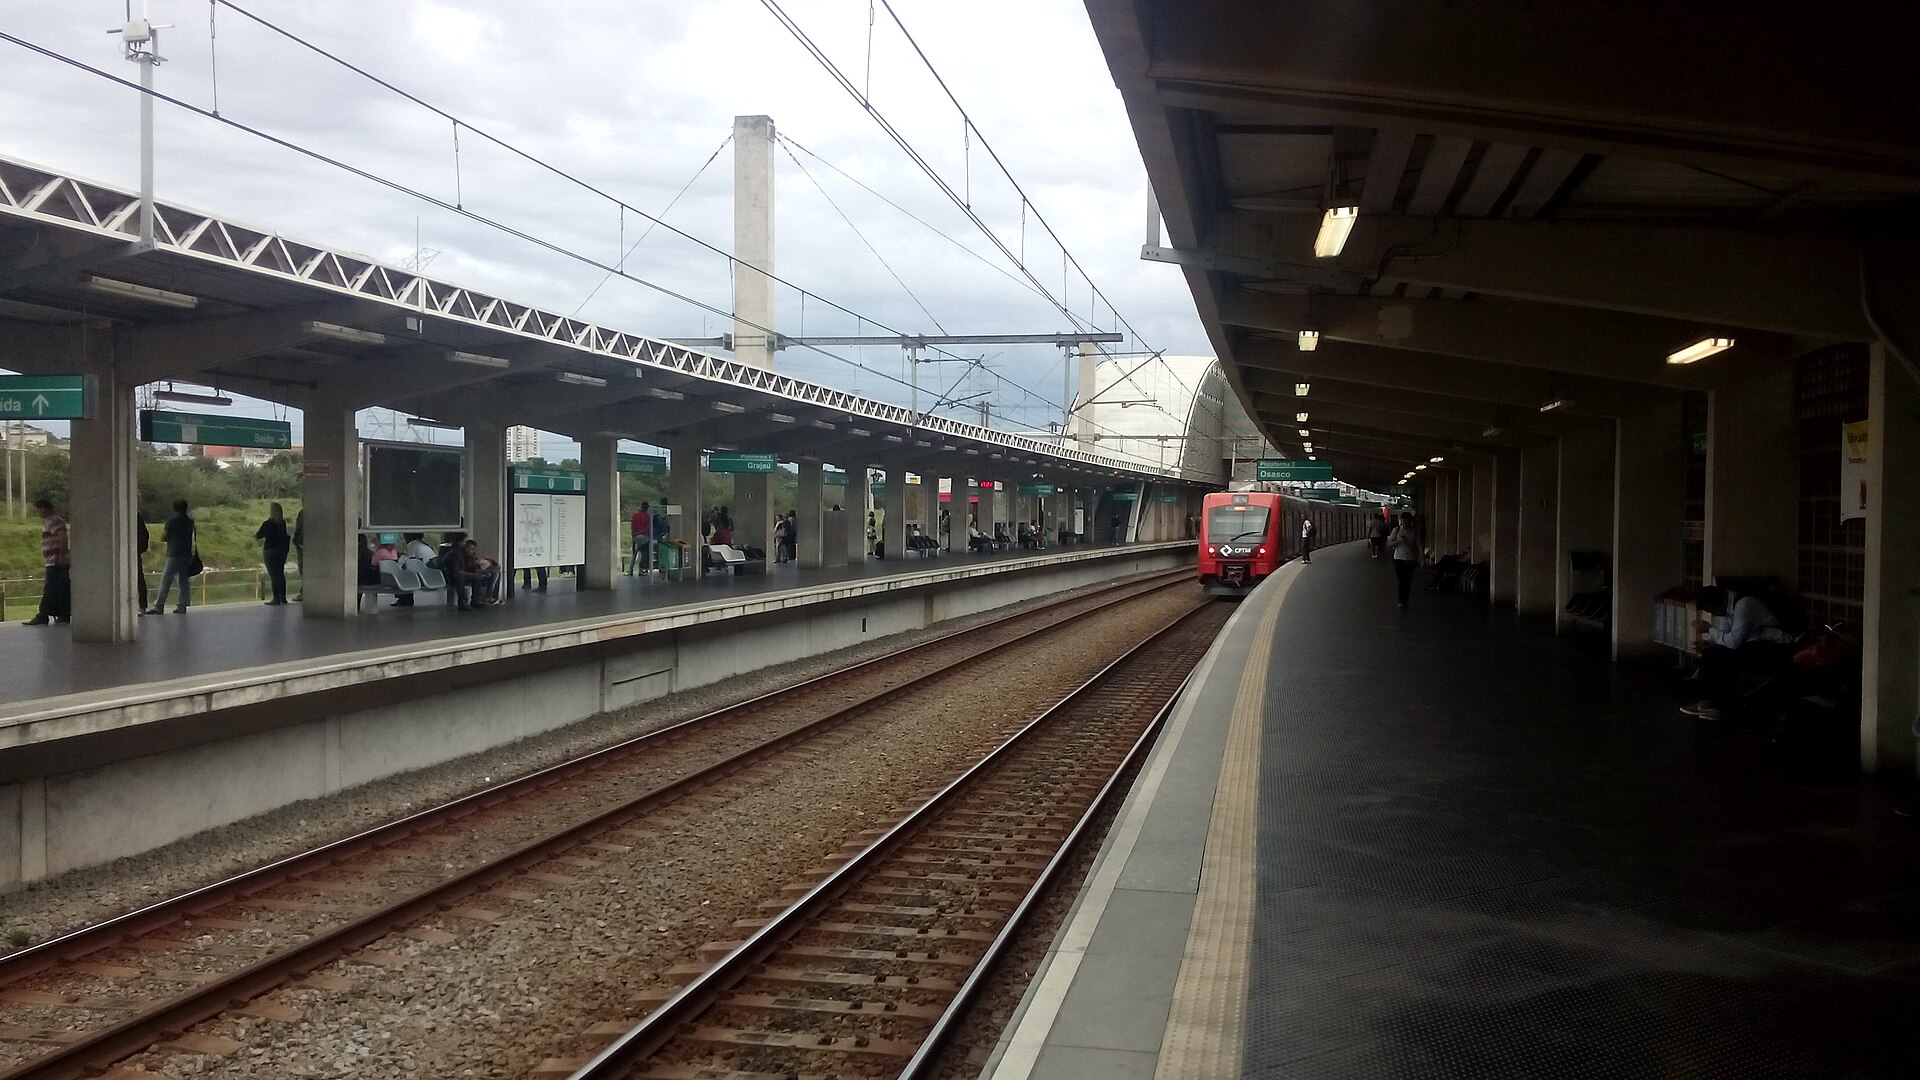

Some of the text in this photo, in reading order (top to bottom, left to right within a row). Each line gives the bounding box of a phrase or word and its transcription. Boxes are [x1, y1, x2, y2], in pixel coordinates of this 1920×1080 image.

[254, 433, 274, 444] Saída
[747, 462, 771, 470] Grajaú
[1260, 470, 1291, 478] Osasco
